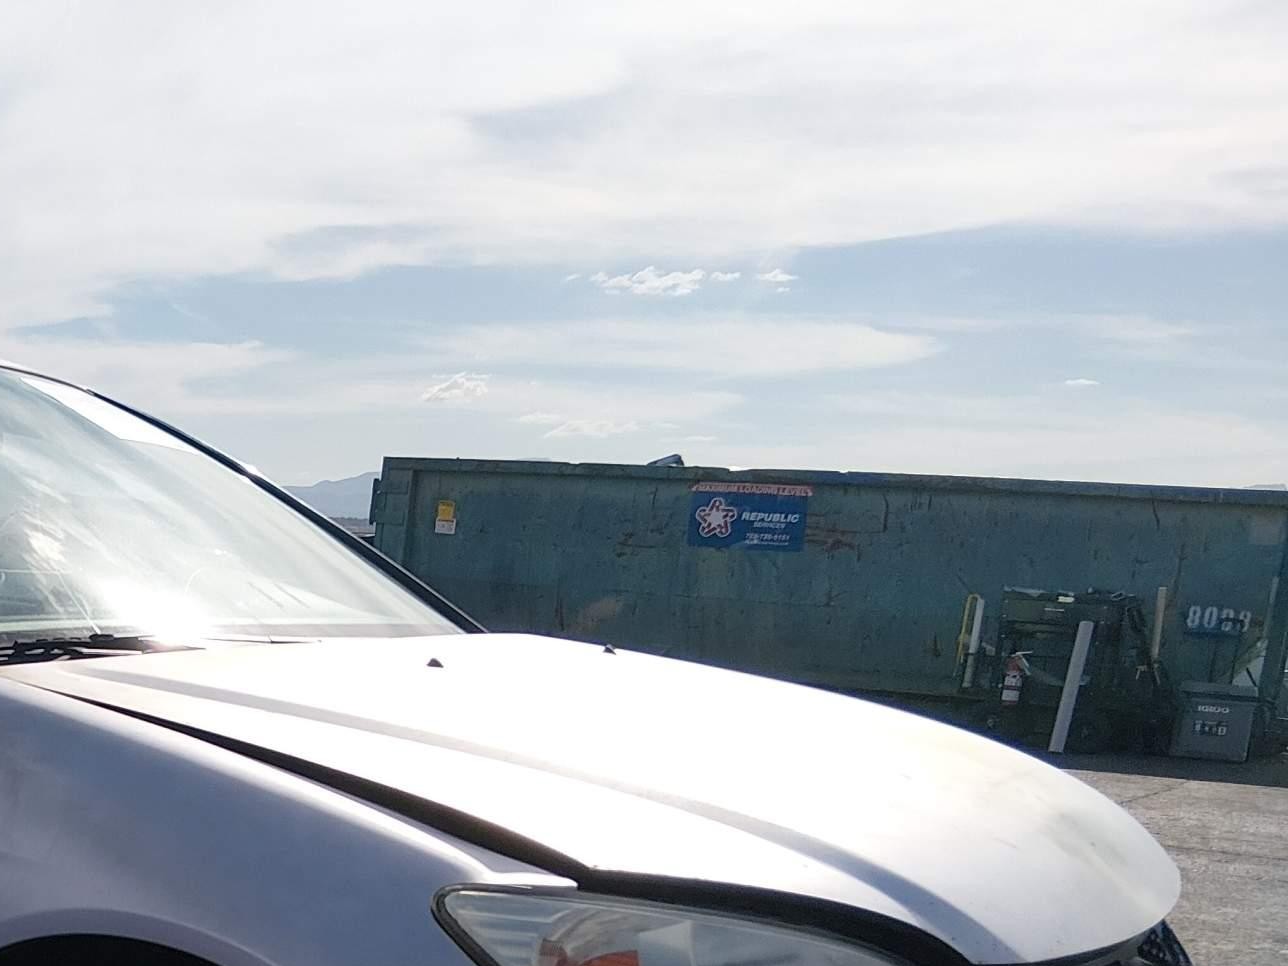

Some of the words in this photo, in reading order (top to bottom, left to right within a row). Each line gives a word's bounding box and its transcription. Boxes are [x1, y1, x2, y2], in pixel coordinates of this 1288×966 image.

[697, 484, 738, 493] MAXIMUM
[739, 485, 778, 495] LOADING
[779, 486, 806, 496] LEVEL
[741, 512, 800, 523] REPUBLIC
